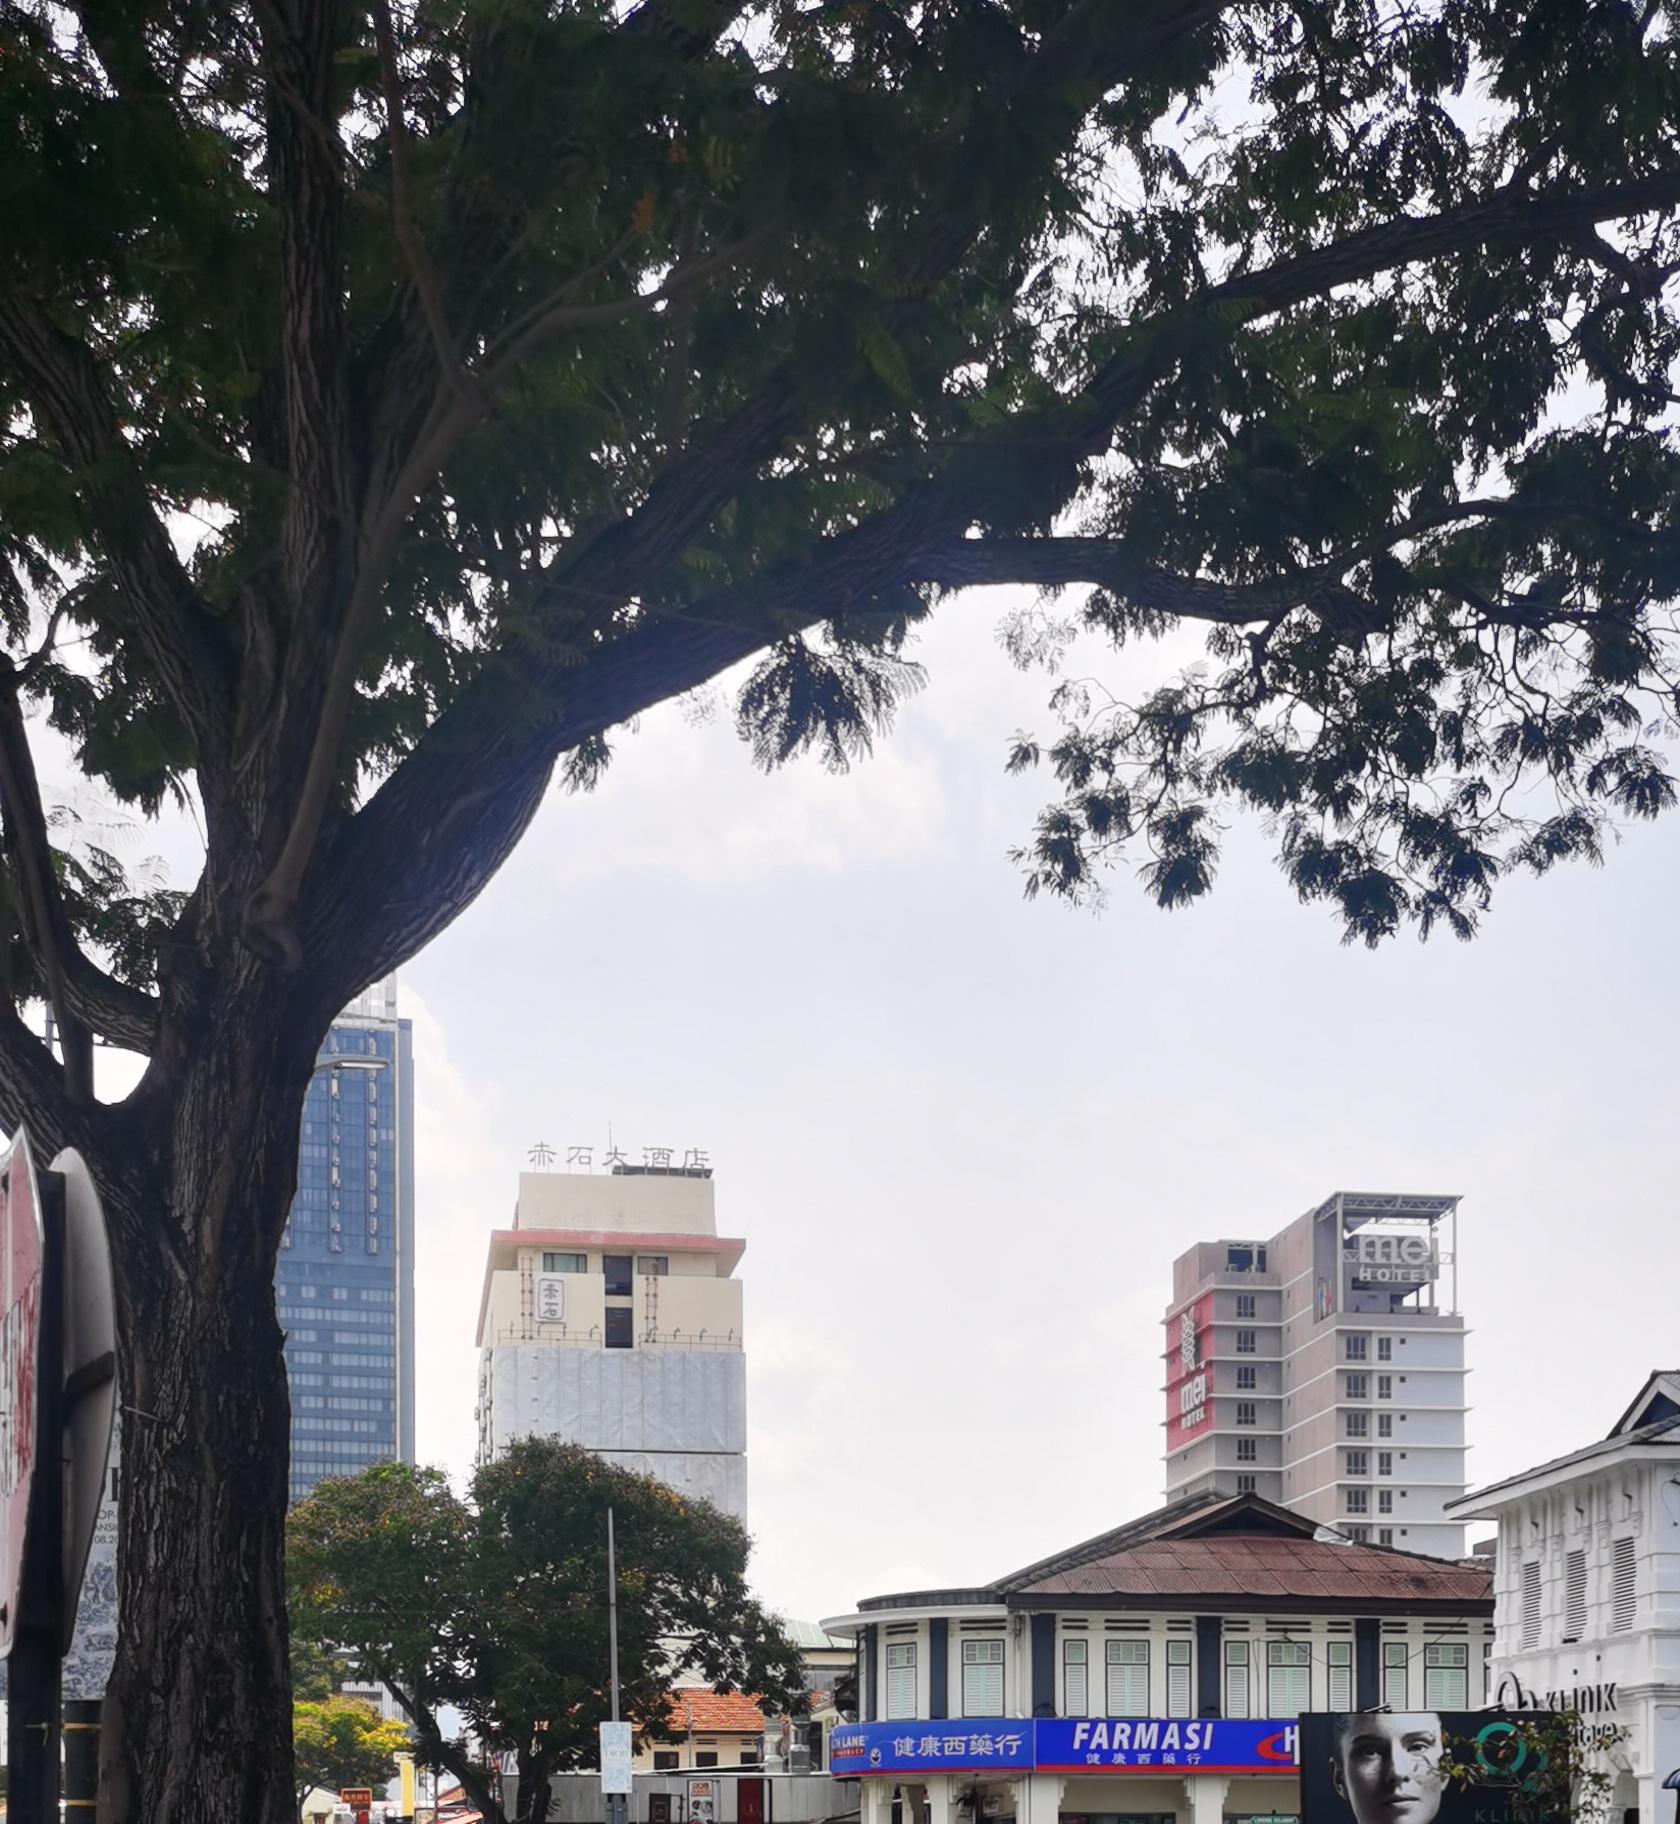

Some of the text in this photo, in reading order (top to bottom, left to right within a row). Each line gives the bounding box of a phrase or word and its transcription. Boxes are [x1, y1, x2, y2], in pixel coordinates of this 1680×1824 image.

[527, 1141, 710, 1172] 赤石大酒店
[1359, 1226, 1439, 1265] mei
[1360, 1266, 1432, 1281] HOTEL
[842, 1735, 866, 1748] LANE
[892, 1733, 1022, 1758] 健康西藥行
[1073, 1722, 1214, 1750] FARMASI
